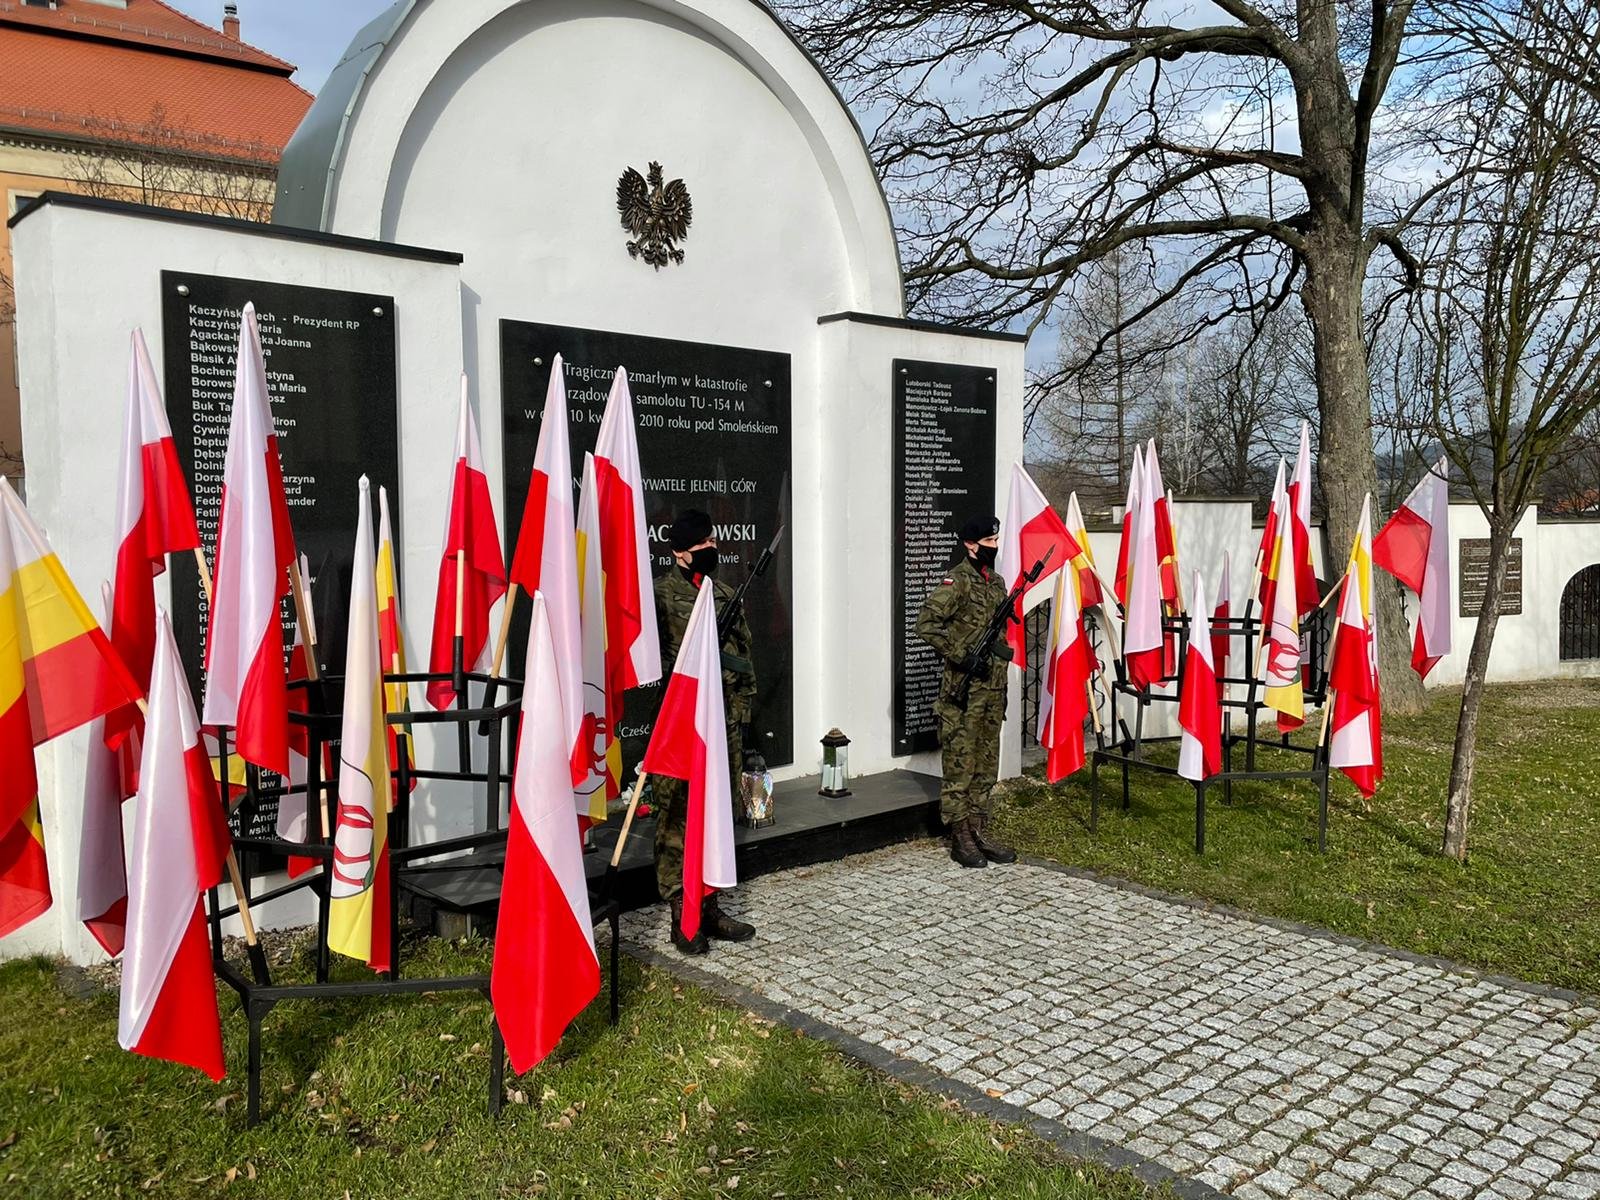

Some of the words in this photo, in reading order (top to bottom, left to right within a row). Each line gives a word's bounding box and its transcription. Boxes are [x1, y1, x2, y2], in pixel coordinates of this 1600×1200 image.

[189, 304, 242, 318] Kaczyńsk
[256, 312, 275, 322] ech
[293, 316, 343, 329] Prezydent
[346, 320, 360, 330] RP
[189, 317, 241, 330] Kaczyńsk
[190, 341, 239, 353] Bąkowsk
[275, 336, 311, 349] Joanna
[190, 353, 224, 364] Błasik
[266, 372, 294, 381] styna
[564, 362, 618, 382] Tragiczni
[629, 370, 677, 387] zmarłym
[681, 378, 691, 386] w
[695, 374, 748, 392] katastrofie
[280, 383, 306, 393] Maria
[192, 389, 233, 400] Borows
[568, 387, 608, 404] rządow
[636, 394, 685, 409] samolotu
[735, 400, 745, 412] M
[192, 401, 214, 410] Buk
[525, 410, 536, 420] w
[570, 409, 583, 422] 10
[640, 414, 664, 428] 2010
[668, 416, 691, 430] roku
[695, 418, 714, 432] pod
[718, 419, 778, 435] Smoleńskiem
[283, 475, 315, 484] arzyna
[642, 478, 686, 492] YWATELE
[690, 478, 727, 494] JELENIEJ
[730, 477, 757, 493] GÓRY
[660, 557, 671, 565] na
[621, 724, 650, 738] Cześć
